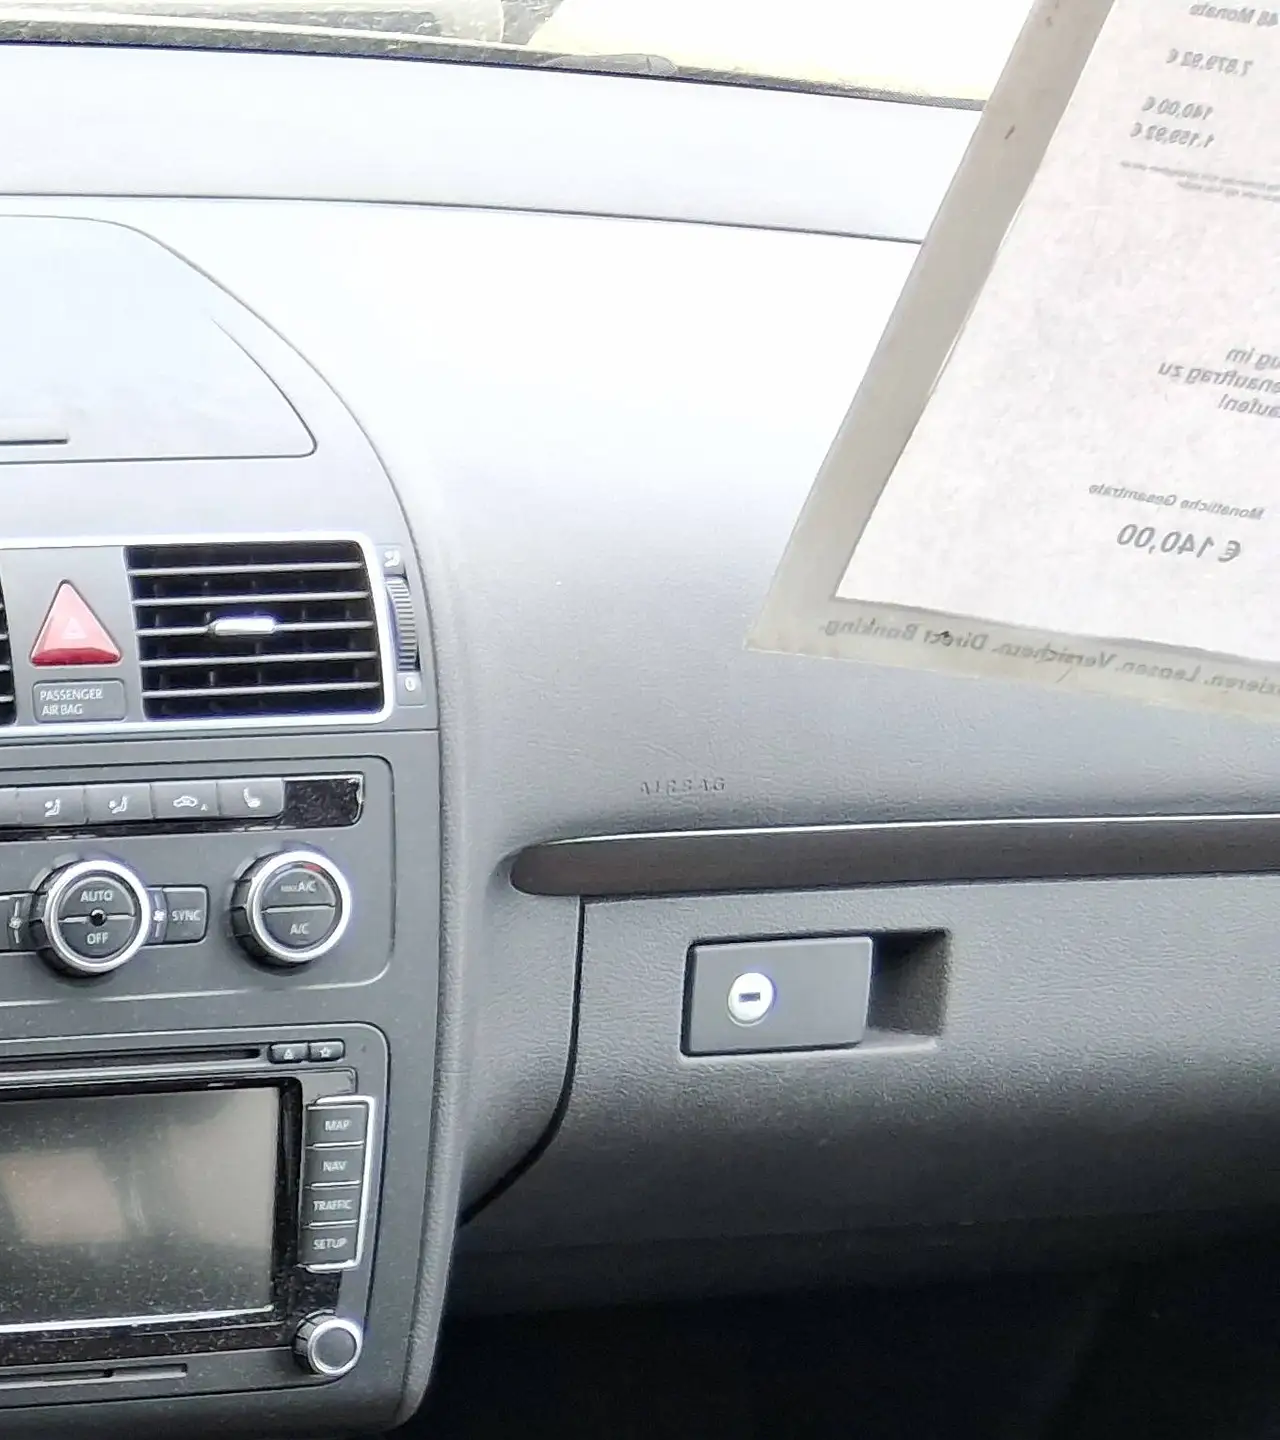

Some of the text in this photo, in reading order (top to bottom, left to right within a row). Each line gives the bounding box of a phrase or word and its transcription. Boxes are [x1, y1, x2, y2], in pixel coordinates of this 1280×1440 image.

[40, 688, 104, 700] PASSENGER
[298, 880, 317, 892] A/C
[80, 890, 113, 903] AUTO
[172, 910, 201, 921] SYNC
[290, 923, 310, 935] A/C
[87, 933, 108, 945] OFF
[325, 1120, 352, 1131] MAP
[323, 1161, 348, 1172] NAV
[313, 1200, 353, 1211] TRAFFIC
[313, 1238, 348, 1250] SETUP
